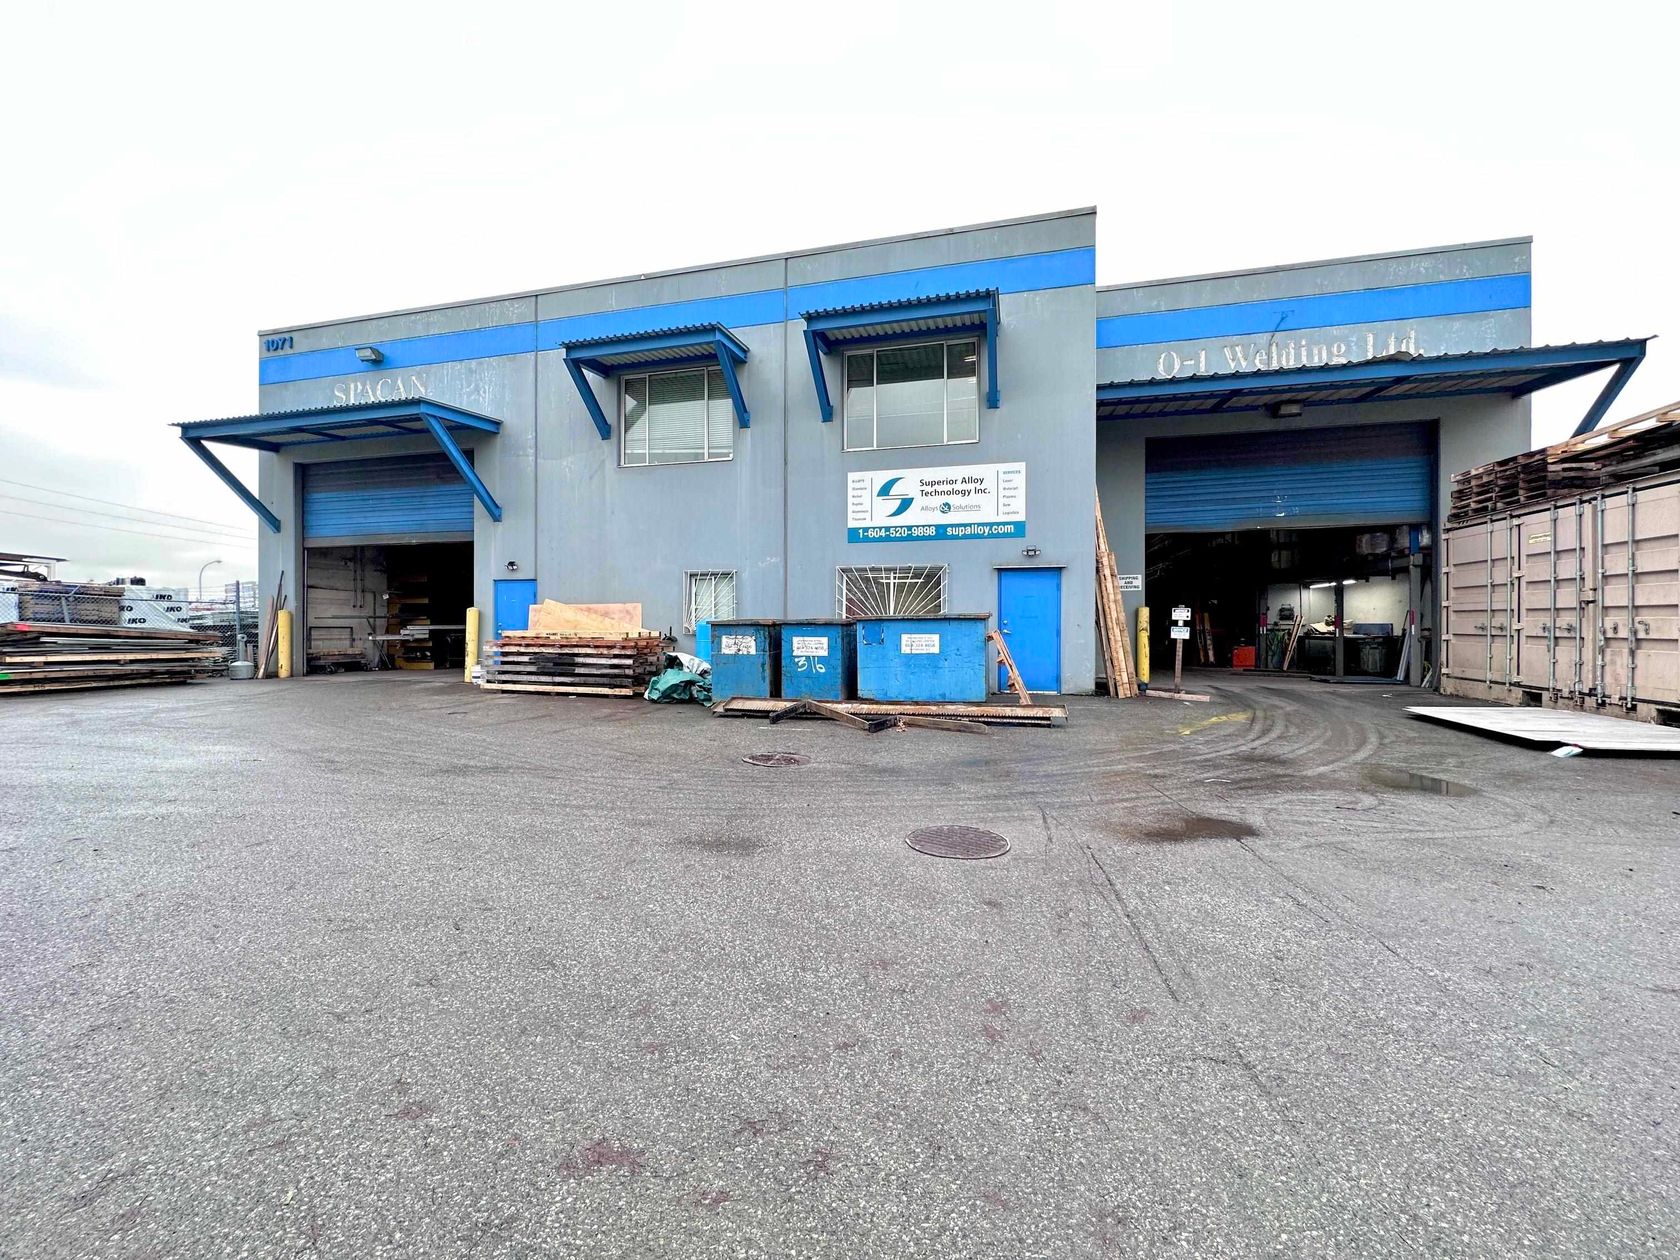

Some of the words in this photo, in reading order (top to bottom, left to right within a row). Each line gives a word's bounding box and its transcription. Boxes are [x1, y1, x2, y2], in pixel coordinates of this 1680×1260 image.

[264, 336, 294, 352] 1071
[1224, 340, 1346, 370] Welding
[333, 374, 427, 406] SPACAN
[919, 478, 958, 488] Superior
[960, 476, 984, 486] Alloy
[920, 488, 971, 498] Technology
[974, 487, 991, 496] Inc.
[920, 504, 939, 513] Alloys
[952, 503, 981, 512] Solutions
[858, 527, 936, 538] 1-604-520-9898
[946, 524, 1014, 537] supalloy.com
[794, 656, 826, 674] 316
